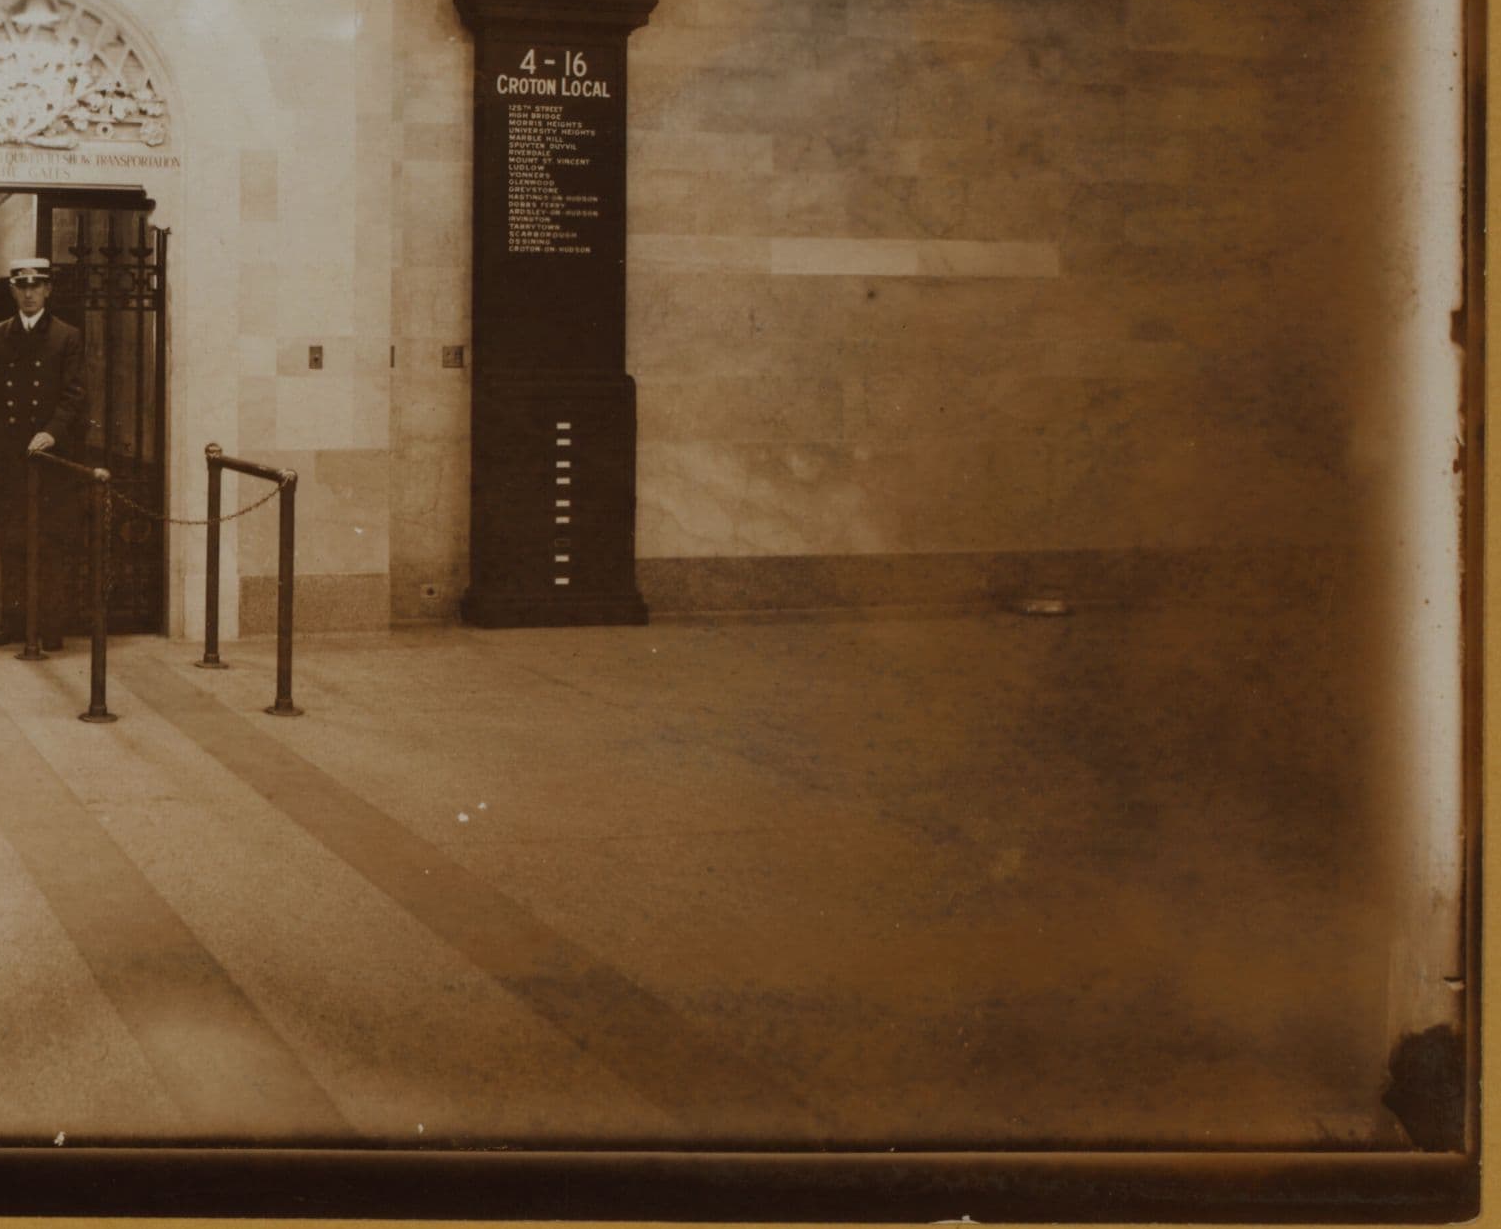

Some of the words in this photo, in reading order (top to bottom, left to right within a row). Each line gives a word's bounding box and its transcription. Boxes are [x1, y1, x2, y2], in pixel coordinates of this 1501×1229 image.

[496, 74, 556, 96] CROTON
[561, 77, 610, 98] LOCAL
[95, 153, 181, 168] TRANSPORTATION
